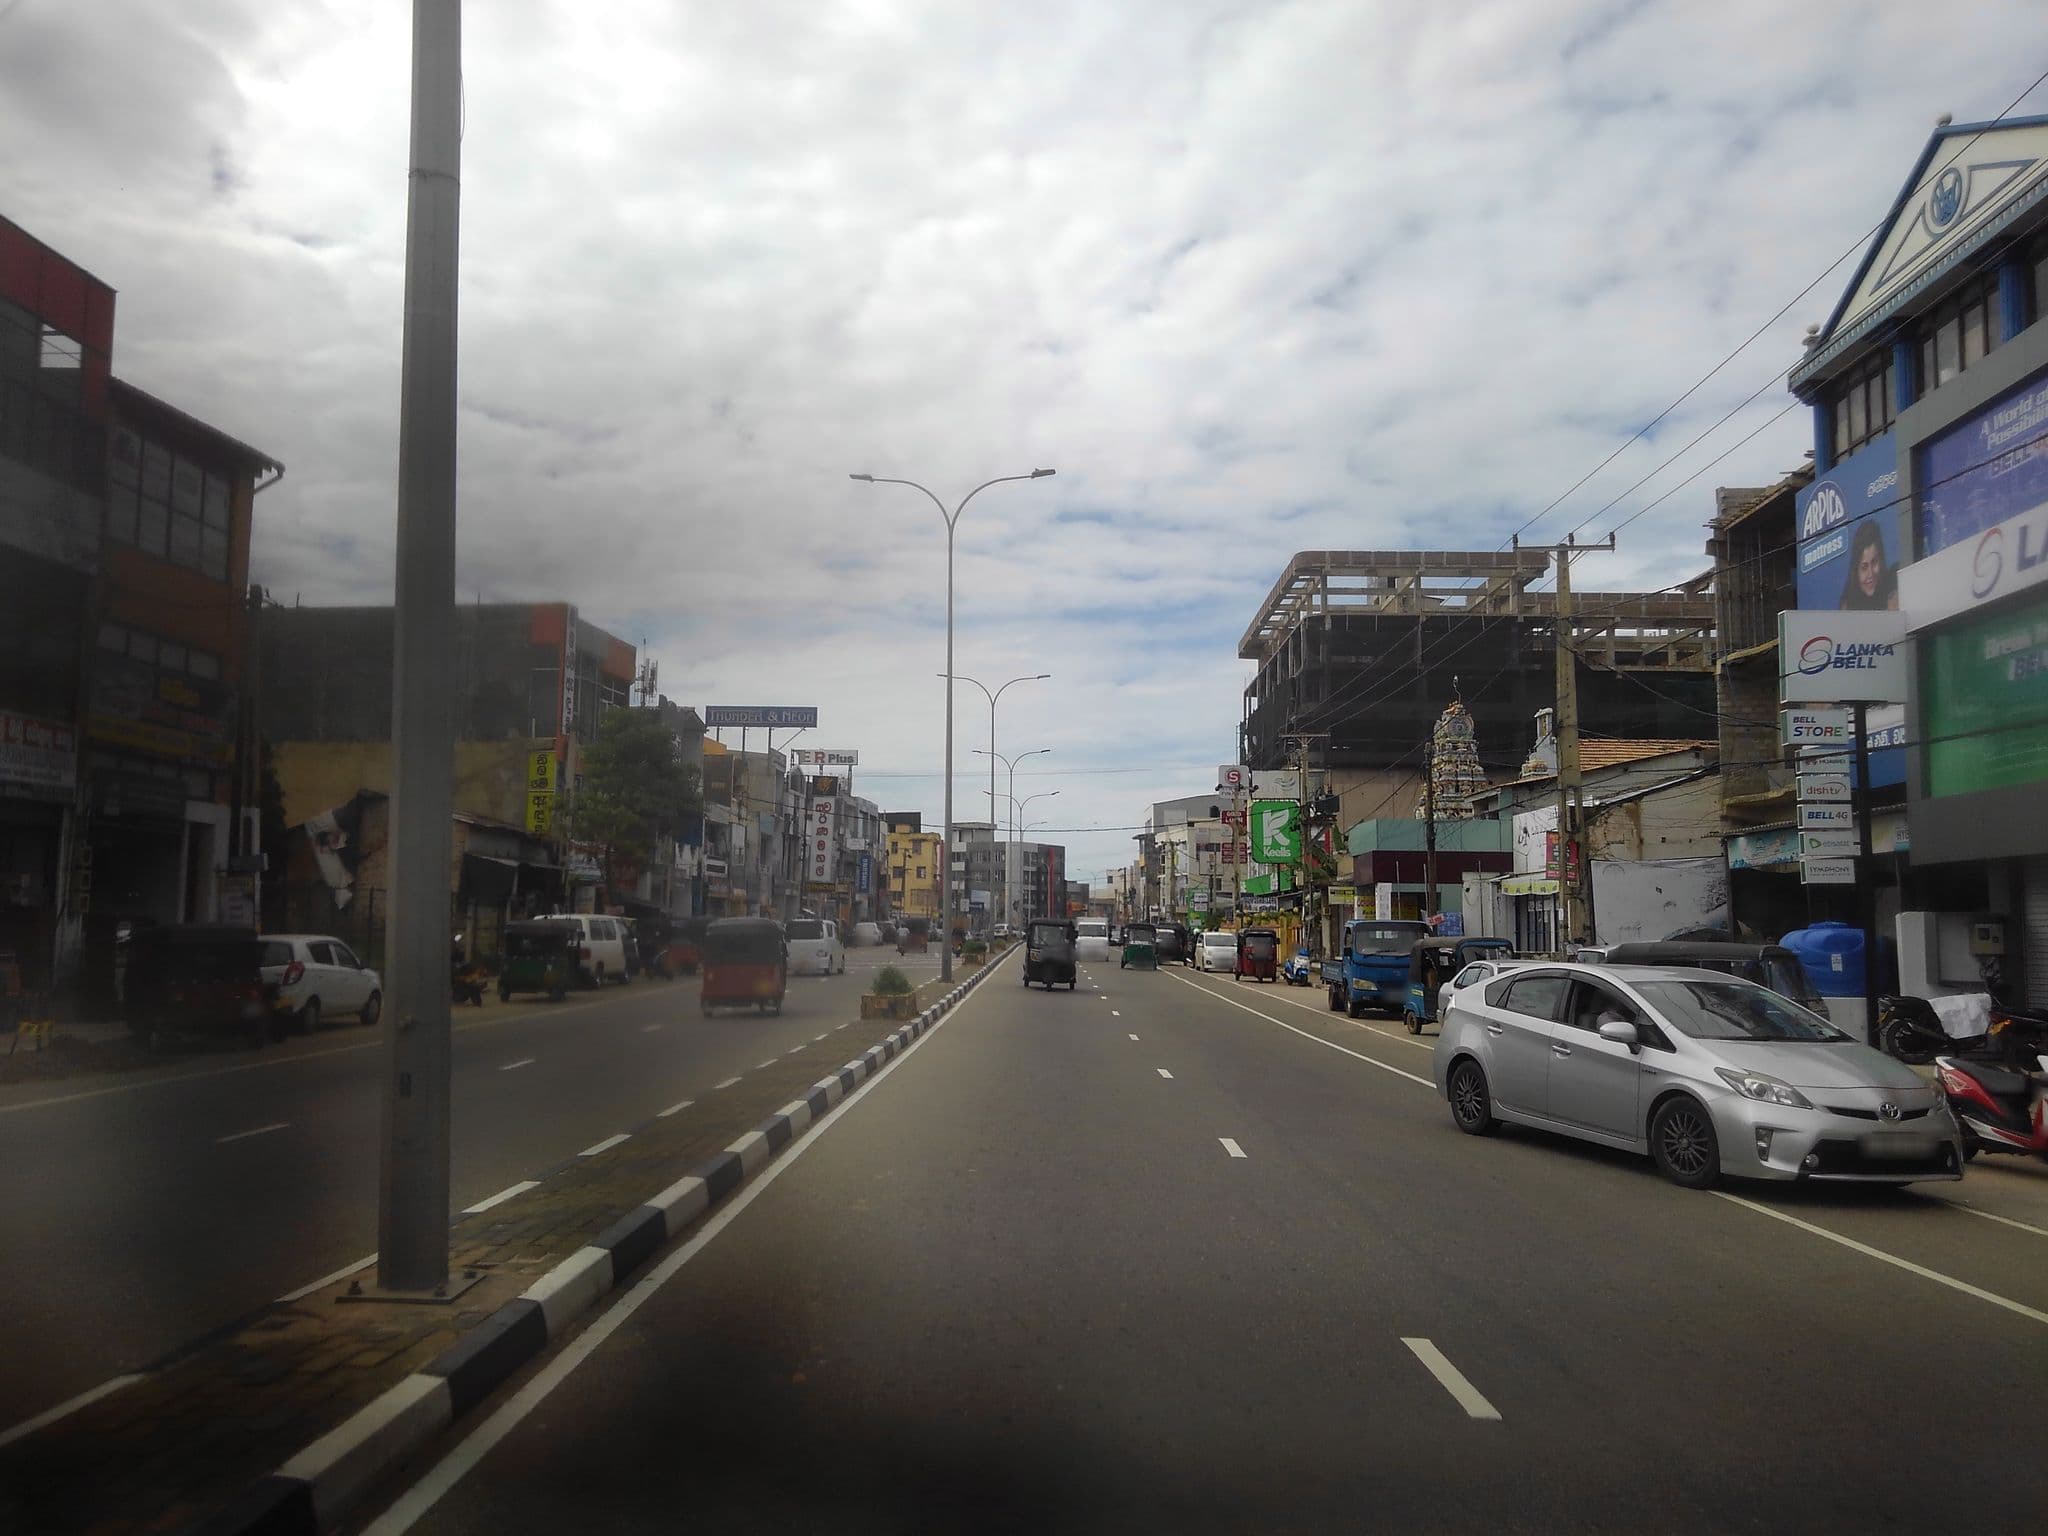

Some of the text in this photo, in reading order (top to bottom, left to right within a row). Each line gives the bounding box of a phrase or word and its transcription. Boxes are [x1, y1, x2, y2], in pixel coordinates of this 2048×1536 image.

[1804, 536, 1843, 566] mattress
[1835, 644, 1894, 656] LANKA
[1833, 657, 1877, 669] BELL
[768, 711, 778, 722] &
[1793, 727, 1843, 737] STORE
[828, 753, 855, 763] Plus
[1263, 847, 1291, 857] Keells
